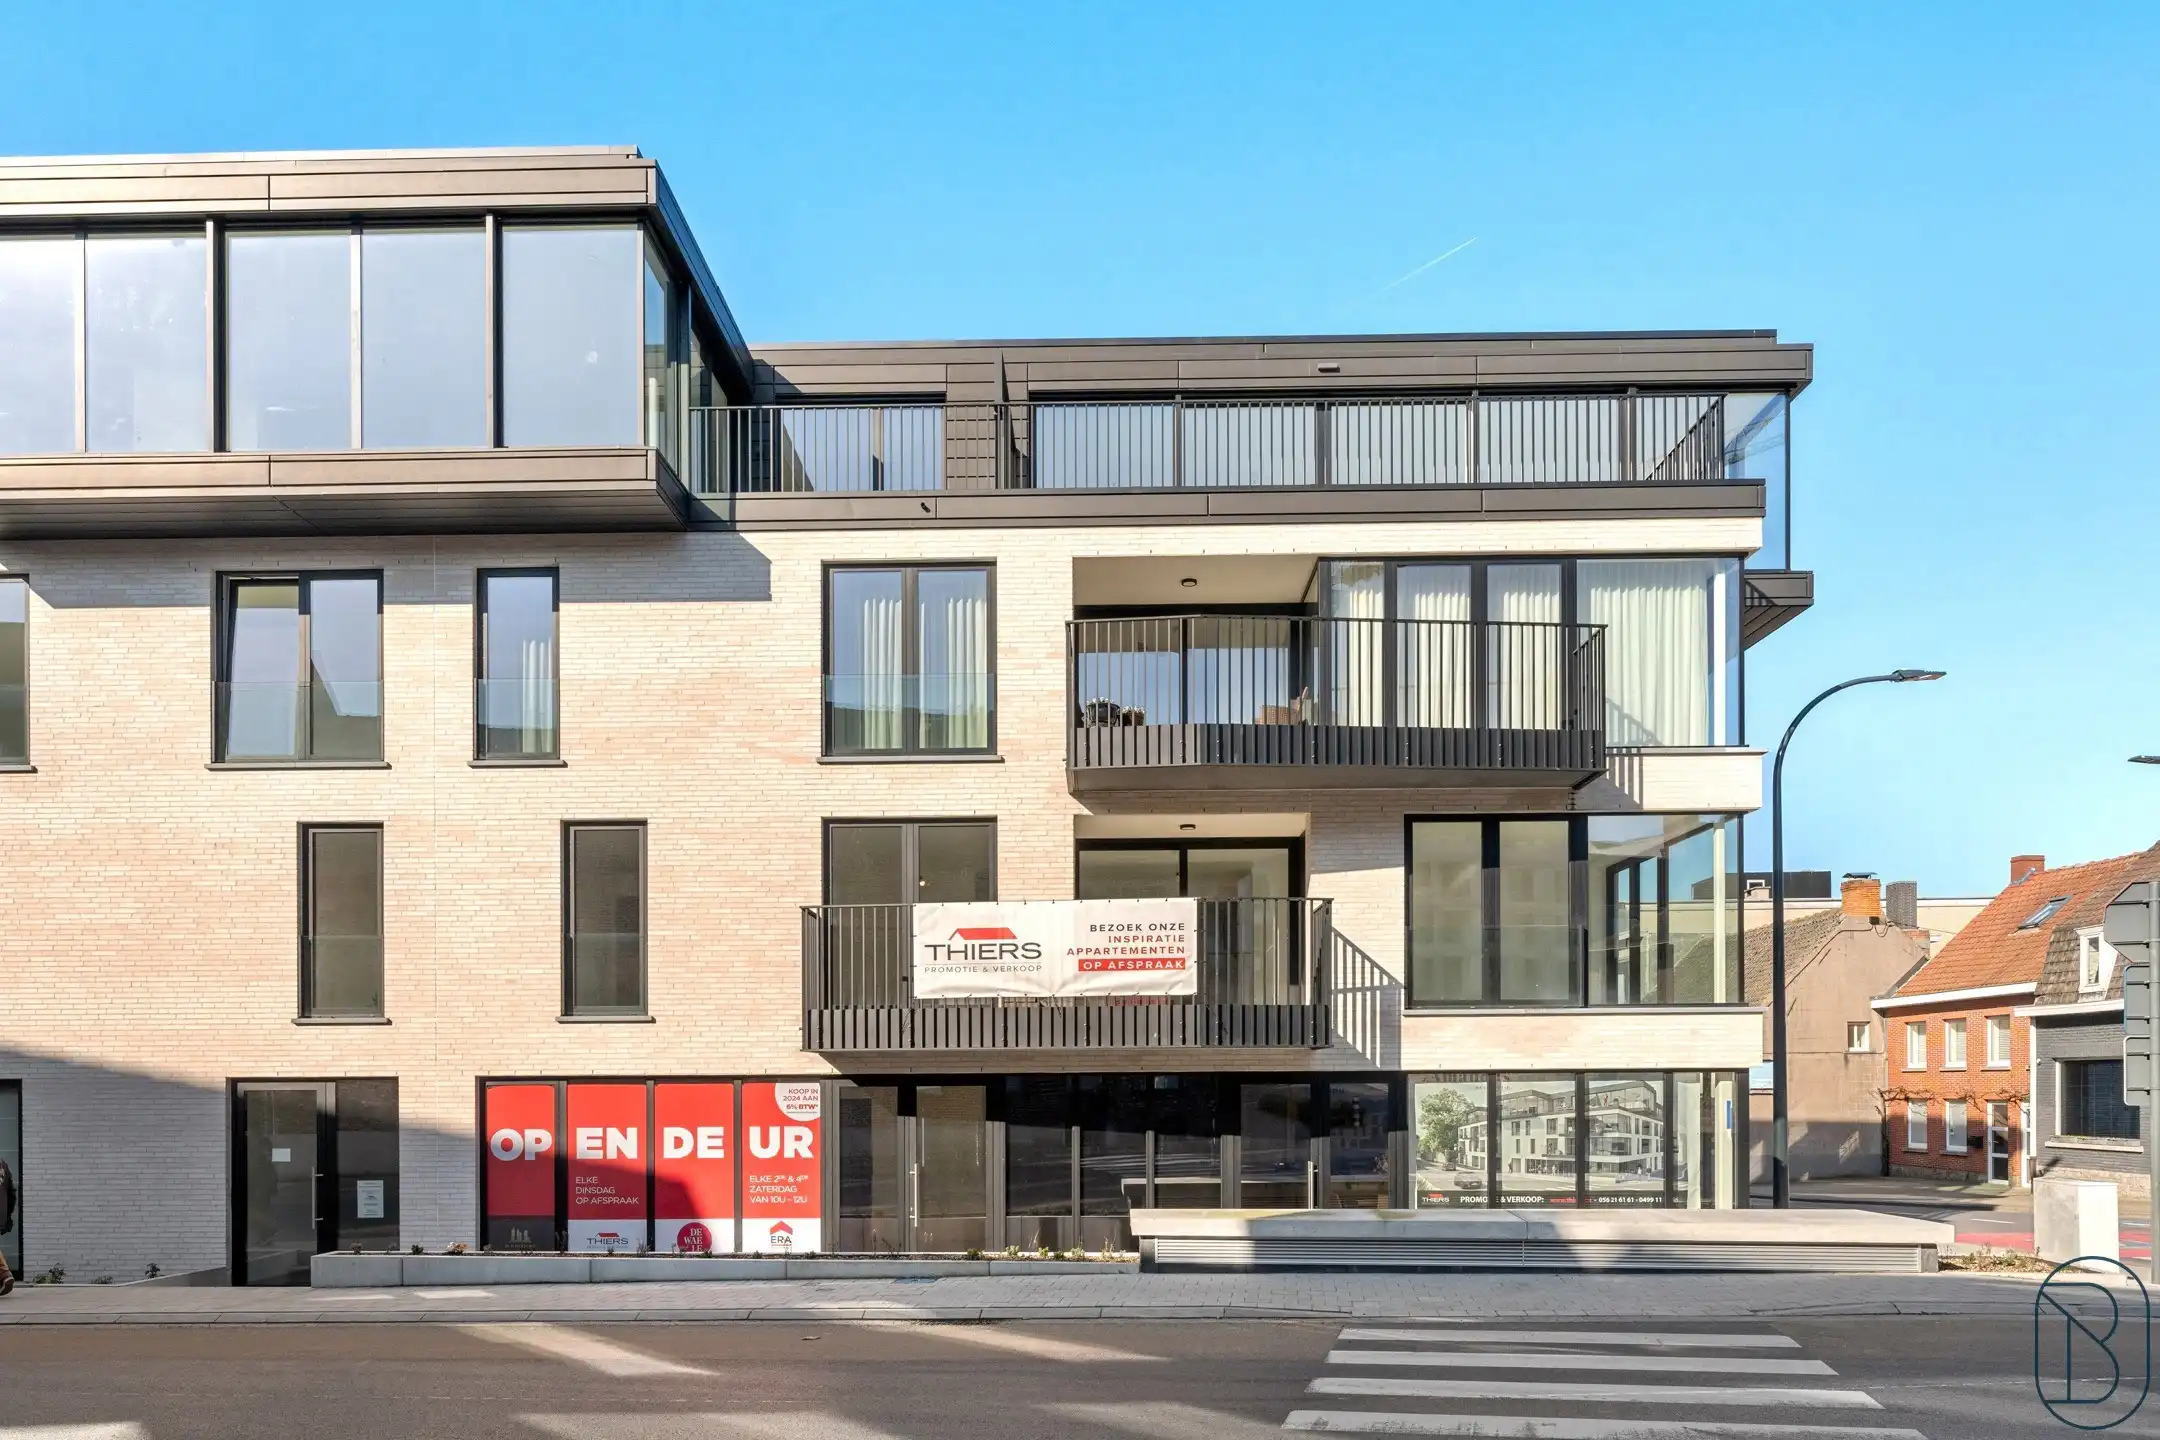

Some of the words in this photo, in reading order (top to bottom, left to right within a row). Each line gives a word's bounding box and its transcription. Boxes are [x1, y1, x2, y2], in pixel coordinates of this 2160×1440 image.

[1090, 924, 1142, 932] BEZOEK
[1149, 923, 1185, 931] ONZE
[1108, 934, 1185, 943] INSPIRATIE
[924, 942, 1042, 961] THIERS
[1067, 945, 1185, 956] APPARTEMENTEN
[924, 965, 978, 973] PROMOTIE
[993, 965, 1042, 973] VERKOOP
[1083, 961, 1102, 970] OP
[1108, 960, 1184, 970] AFSPRAAK
[490, 1128, 552, 1161] OP
[576, 1127, 638, 1159] EN
[663, 1126, 725, 1159] DE
[749, 1126, 814, 1159] UR
[576, 1176, 598, 1184] ELKE
[749, 1175, 772, 1183] ELKE
[576, 1186, 616, 1194] DINSDAG
[749, 1185, 797, 1193] ZATERDAG
[575, 1197, 589, 1205] OP
[590, 1197, 639, 1205] AFSPRAAK
[749, 1195, 769, 1204] VAN
[1500, 1195, 1507, 1203] &
[1507, 1195, 1544, 1203] VERKOOP:
[690, 1228, 703, 1236] DE
[770, 1235, 792, 1244] ERA
